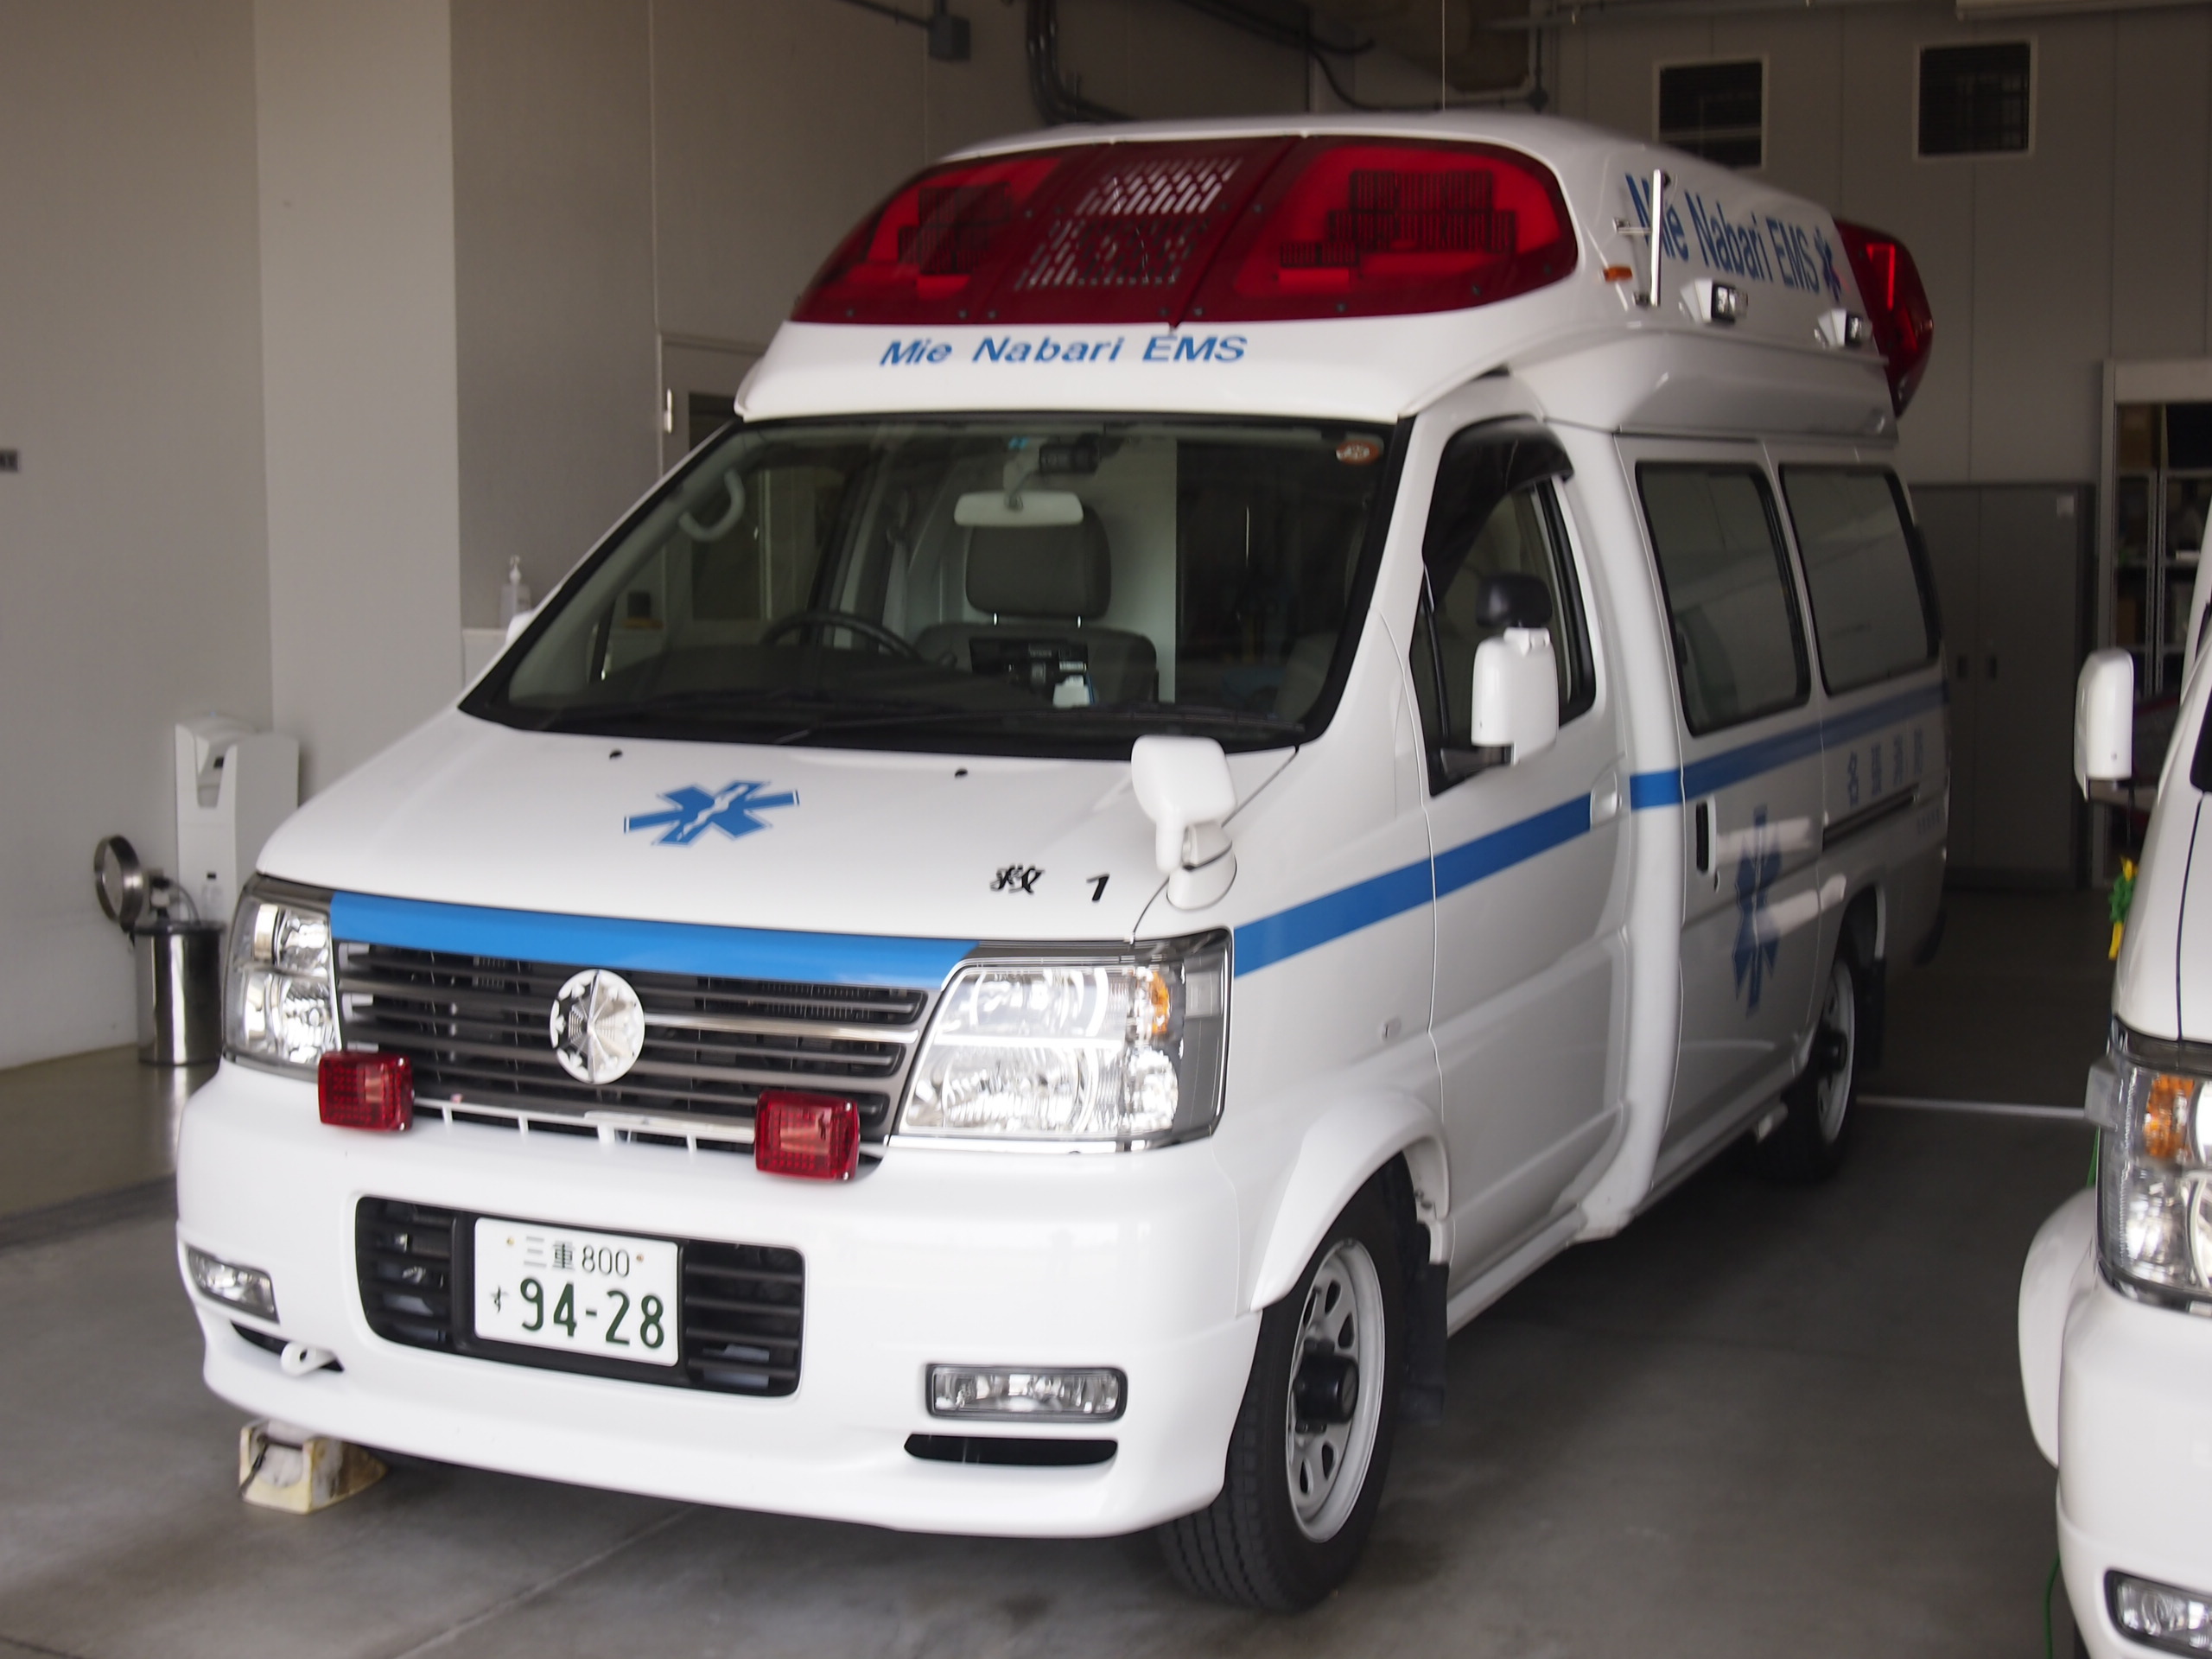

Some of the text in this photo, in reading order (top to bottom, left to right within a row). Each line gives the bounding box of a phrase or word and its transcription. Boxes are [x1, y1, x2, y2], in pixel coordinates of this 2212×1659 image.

[1625, 173, 1820, 295] Mie Nabari EMS
[880, 334, 1248, 366] Mie Nabari EMS
[1086, 873, 1110, 902] 1
[519, 1275, 665, 1349] 94-28
